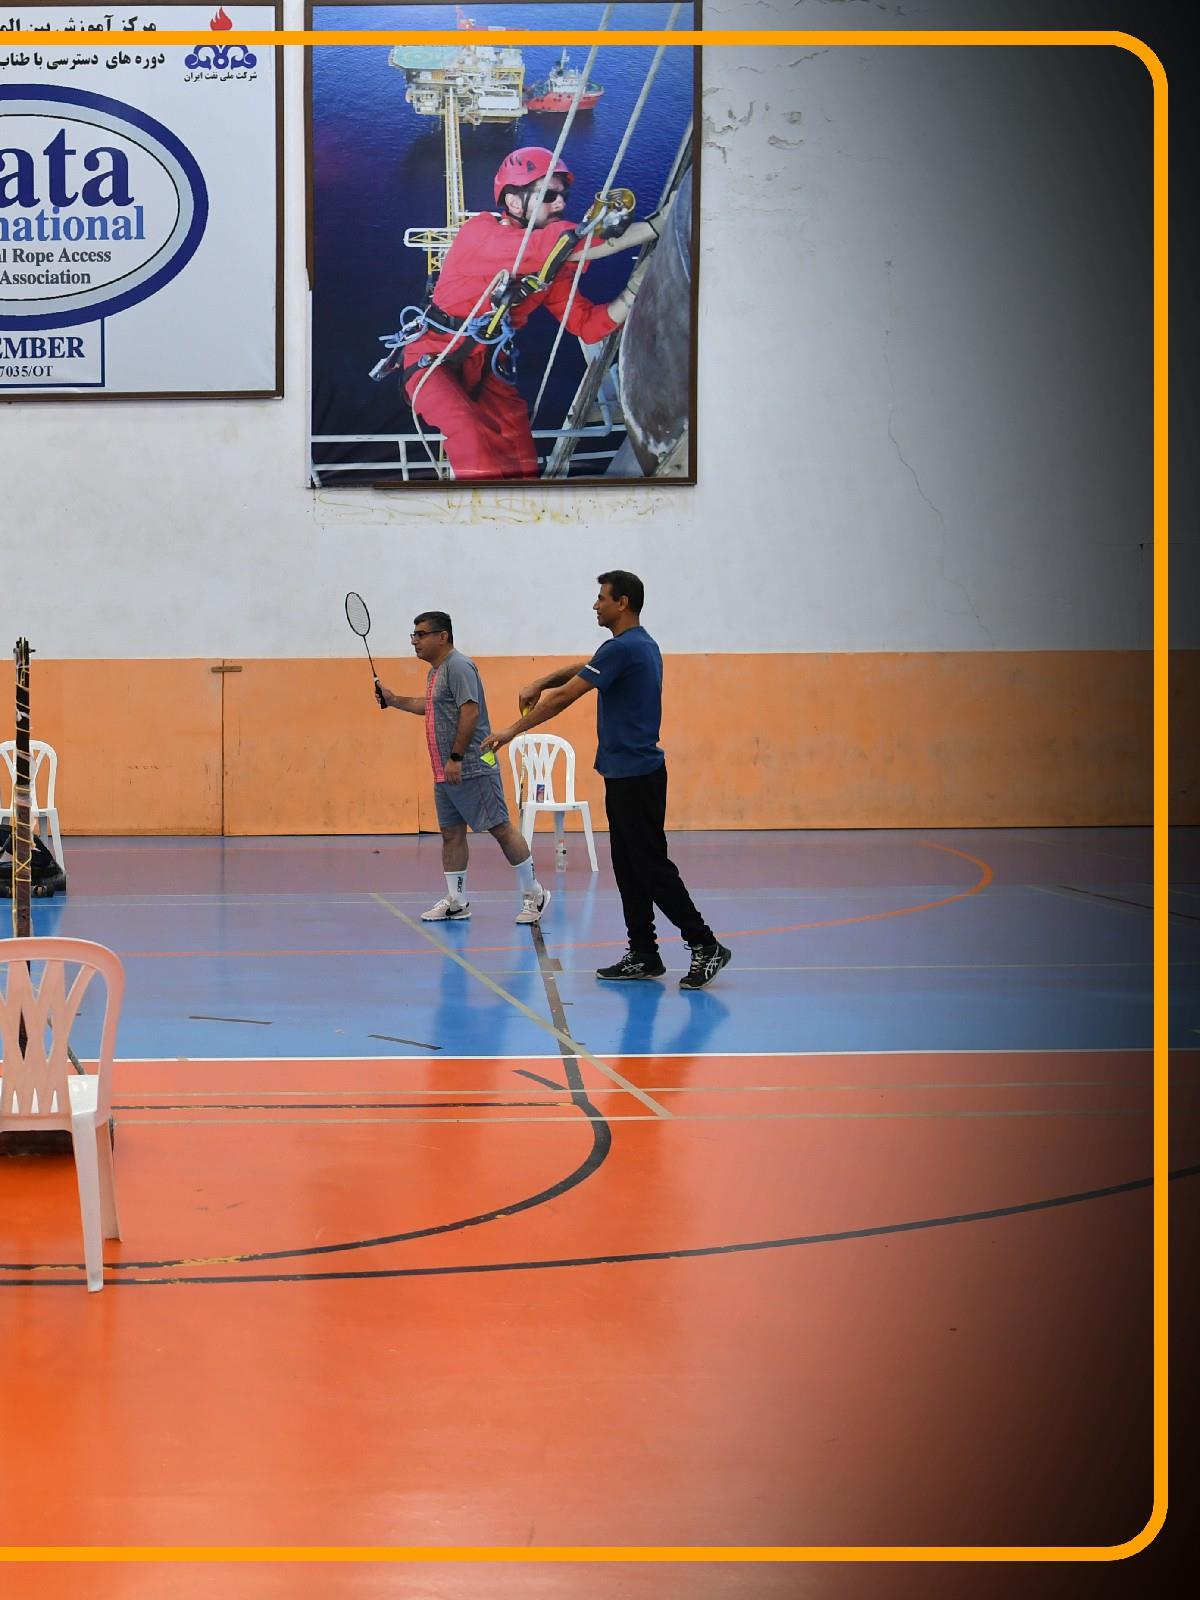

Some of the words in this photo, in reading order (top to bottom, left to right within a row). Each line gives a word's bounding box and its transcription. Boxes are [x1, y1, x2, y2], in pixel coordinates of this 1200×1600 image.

[33, 52, 43, 70] با
[46, 53, 99, 70] دسترسی
[105, 51, 132, 70] های
[134, 53, 165, 70] دوره
[184, 72, 203, 82] ایران
[205, 72, 218, 80] نفت
[220, 72, 234, 82] ملی
[236, 71, 257, 82] شرکت
[12, 247, 54, 267] Rope
[58, 247, 112, 263] Access
[0, 269, 92, 285] Association
